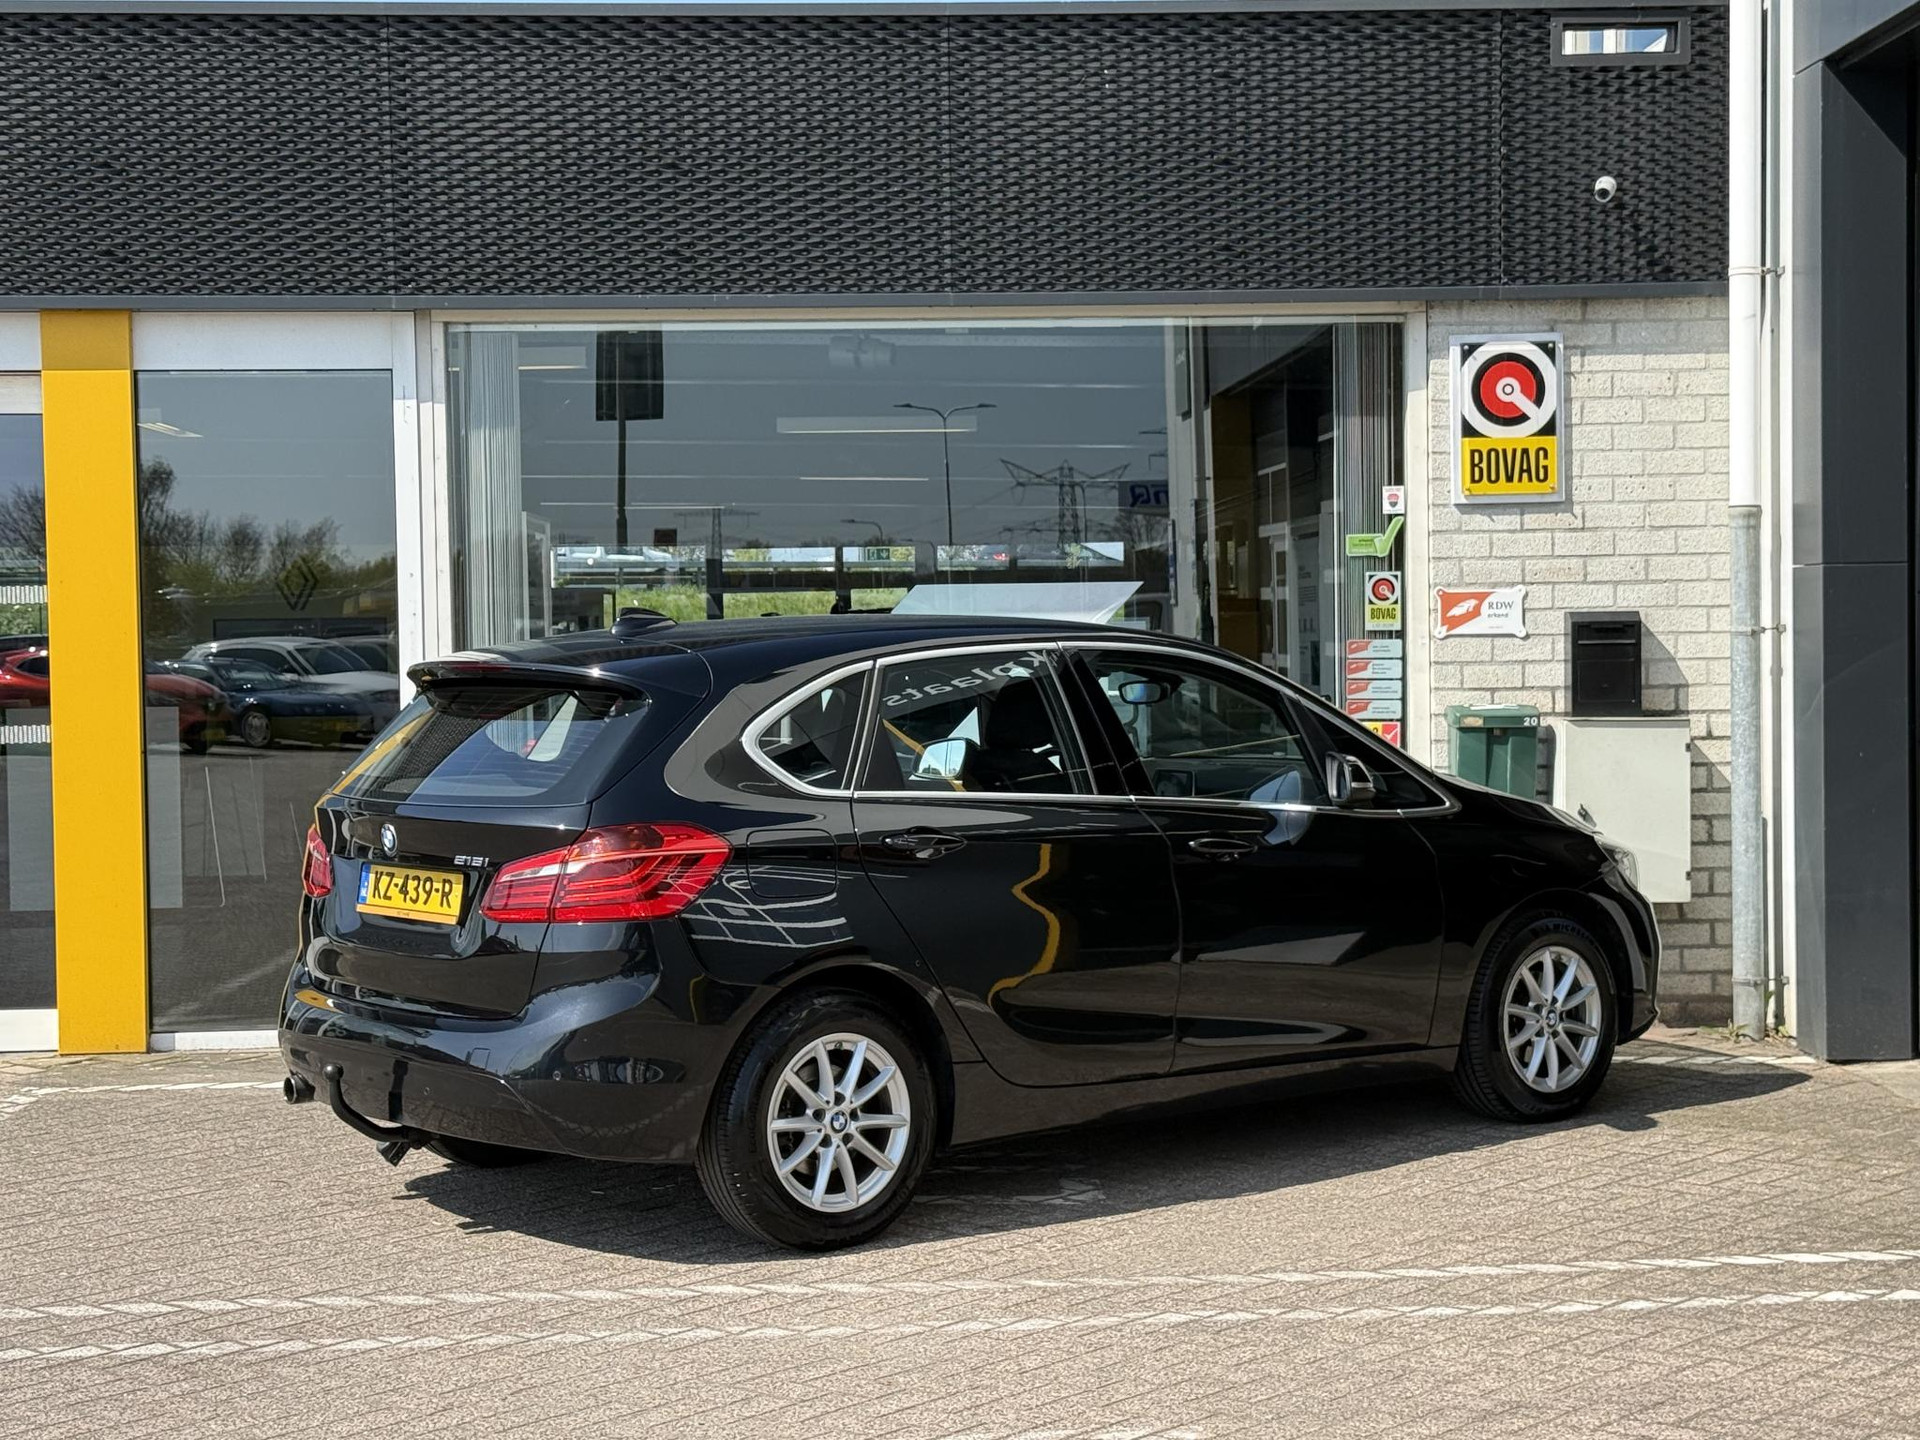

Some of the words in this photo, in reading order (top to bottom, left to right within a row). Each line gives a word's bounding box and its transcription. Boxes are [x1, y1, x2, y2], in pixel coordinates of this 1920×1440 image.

[1469, 446, 1549, 484] BOVAG
[1488, 600, 1514, 610] RDW
[1371, 607, 1397, 620] BOVAG
[1523, 716, 1538, 726] 20
[372, 870, 453, 909] KZ-439-R
